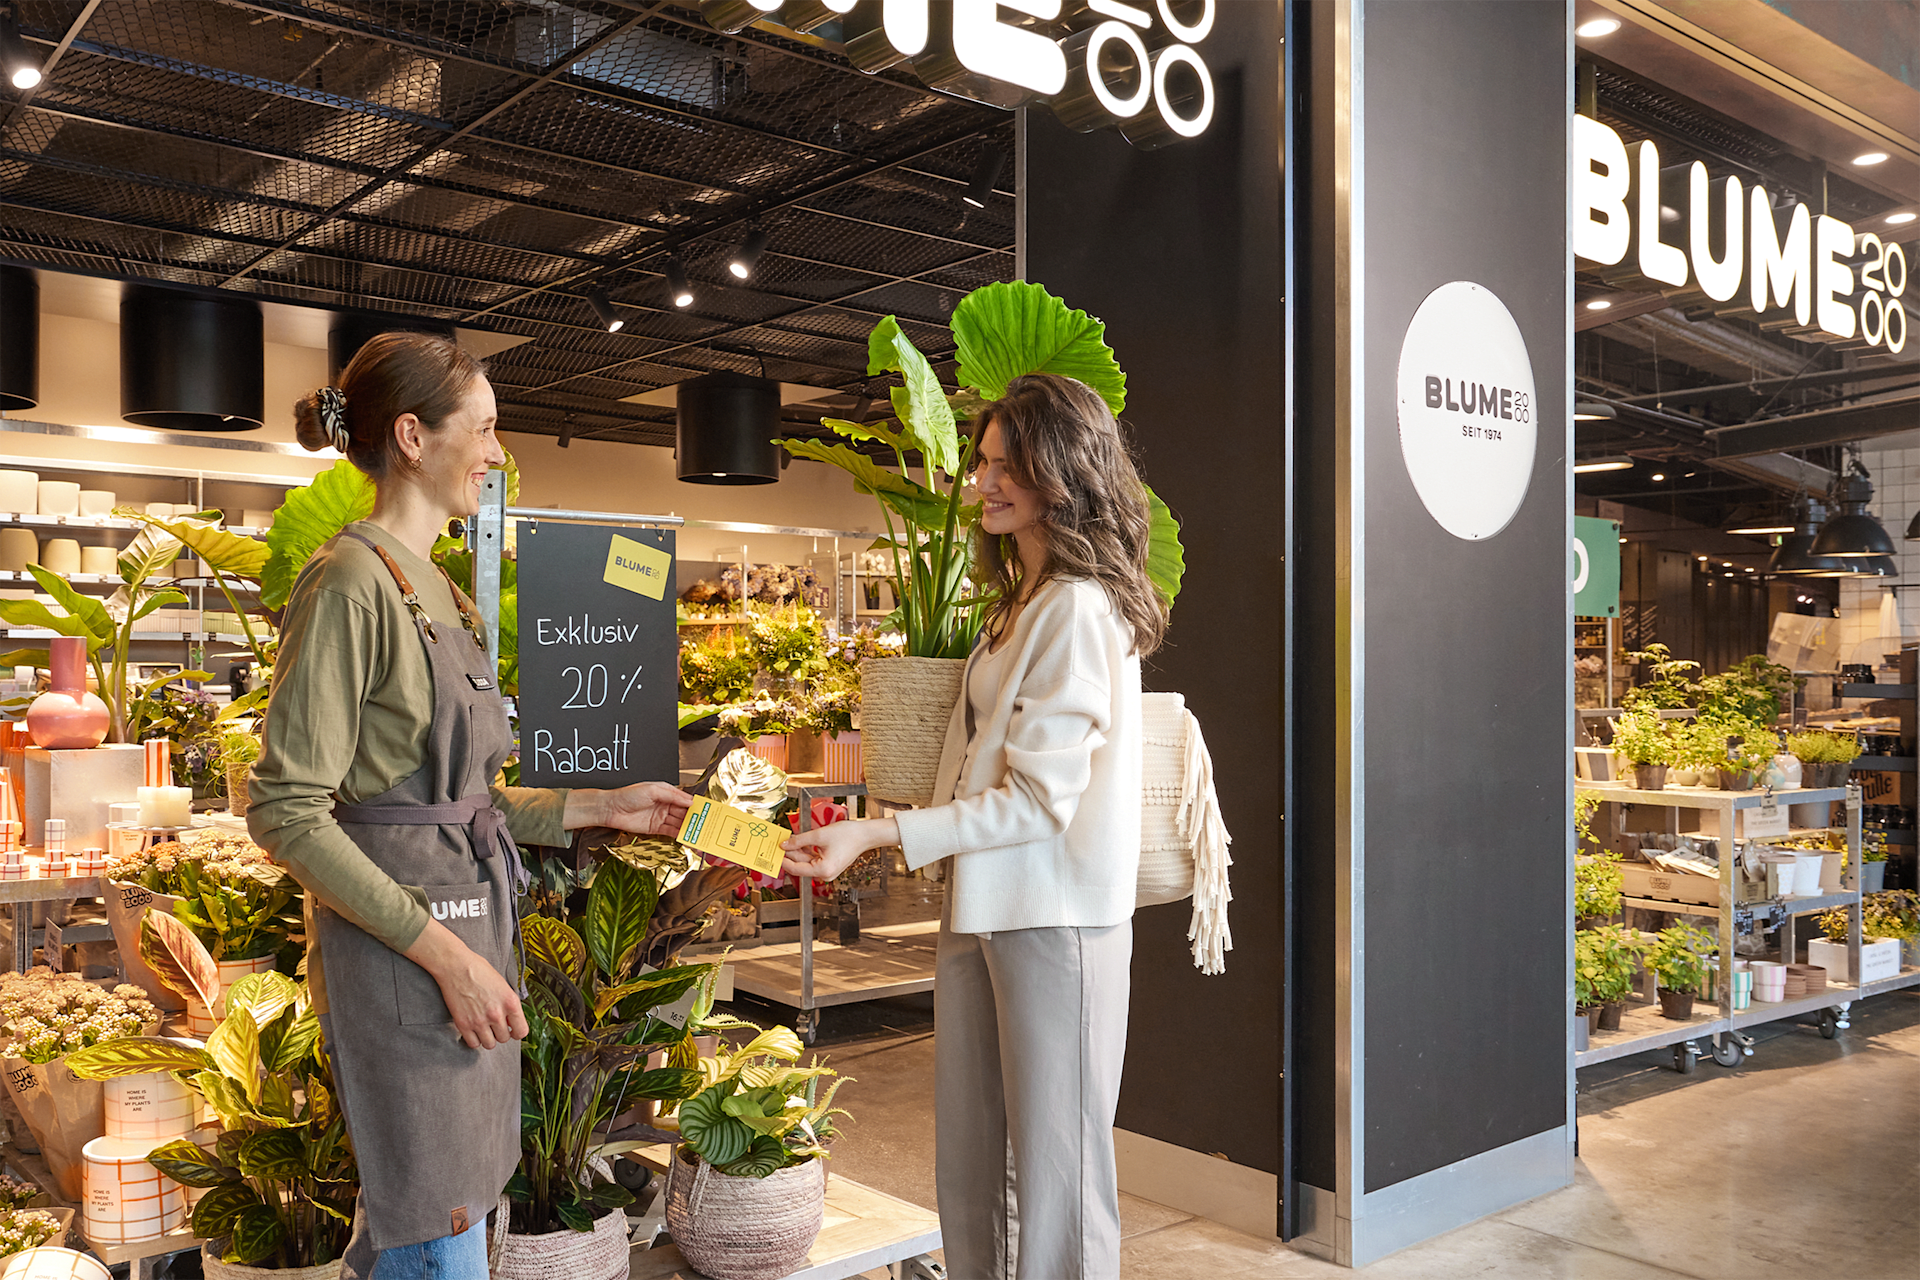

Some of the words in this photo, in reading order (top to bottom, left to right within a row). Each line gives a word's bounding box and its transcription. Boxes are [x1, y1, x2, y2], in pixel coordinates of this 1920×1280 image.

[1574, 113, 1857, 339] BLUME
[1425, 375, 1513, 420] BLUME
[1462, 425, 1482, 438] SEIT
[1484, 428, 1502, 441] 1974
[615, 555, 652, 577] BLUME
[536, 613, 639, 645] Exklusiv
[561, 663, 608, 709] 20
[620, 665, 643, 704] %
[534, 723, 630, 773] Rabatt
[120, 887, 151, 900] BLUM
[125, 893, 152, 908] 2000
